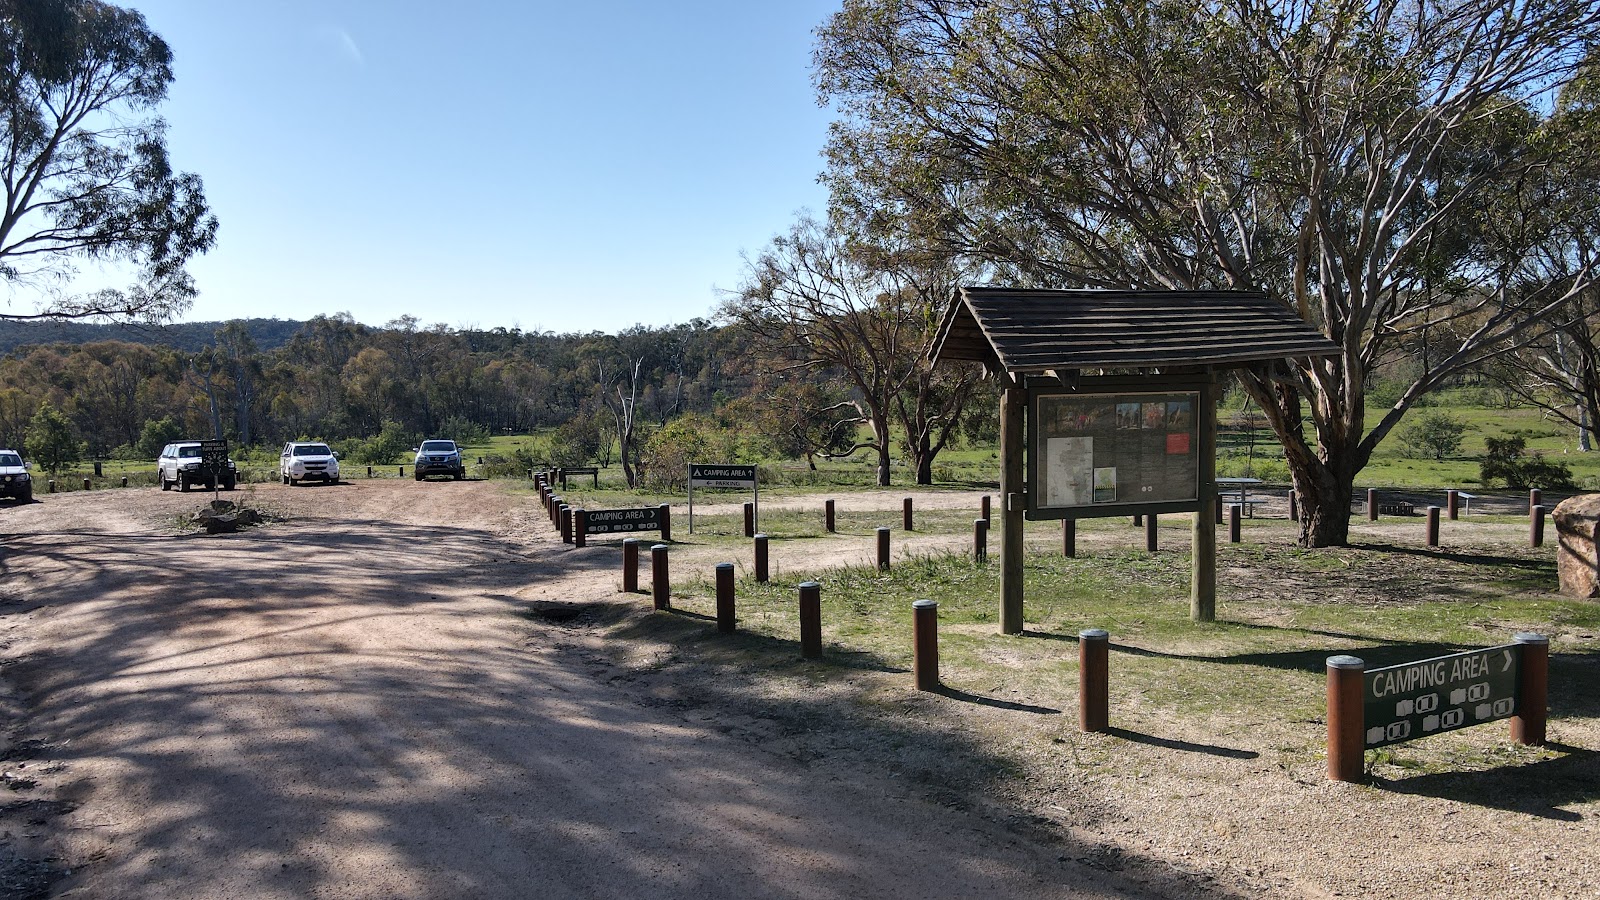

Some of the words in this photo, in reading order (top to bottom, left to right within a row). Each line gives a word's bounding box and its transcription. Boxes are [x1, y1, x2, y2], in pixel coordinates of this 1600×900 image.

[703, 469, 730, 477] CAMPING
[730, 469, 746, 477] AREA
[589, 512, 623, 522] CAMPING
[625, 510, 644, 520] AREA
[1372, 661, 1446, 698] CAMPING
[1450, 654, 1490, 682] AREA
